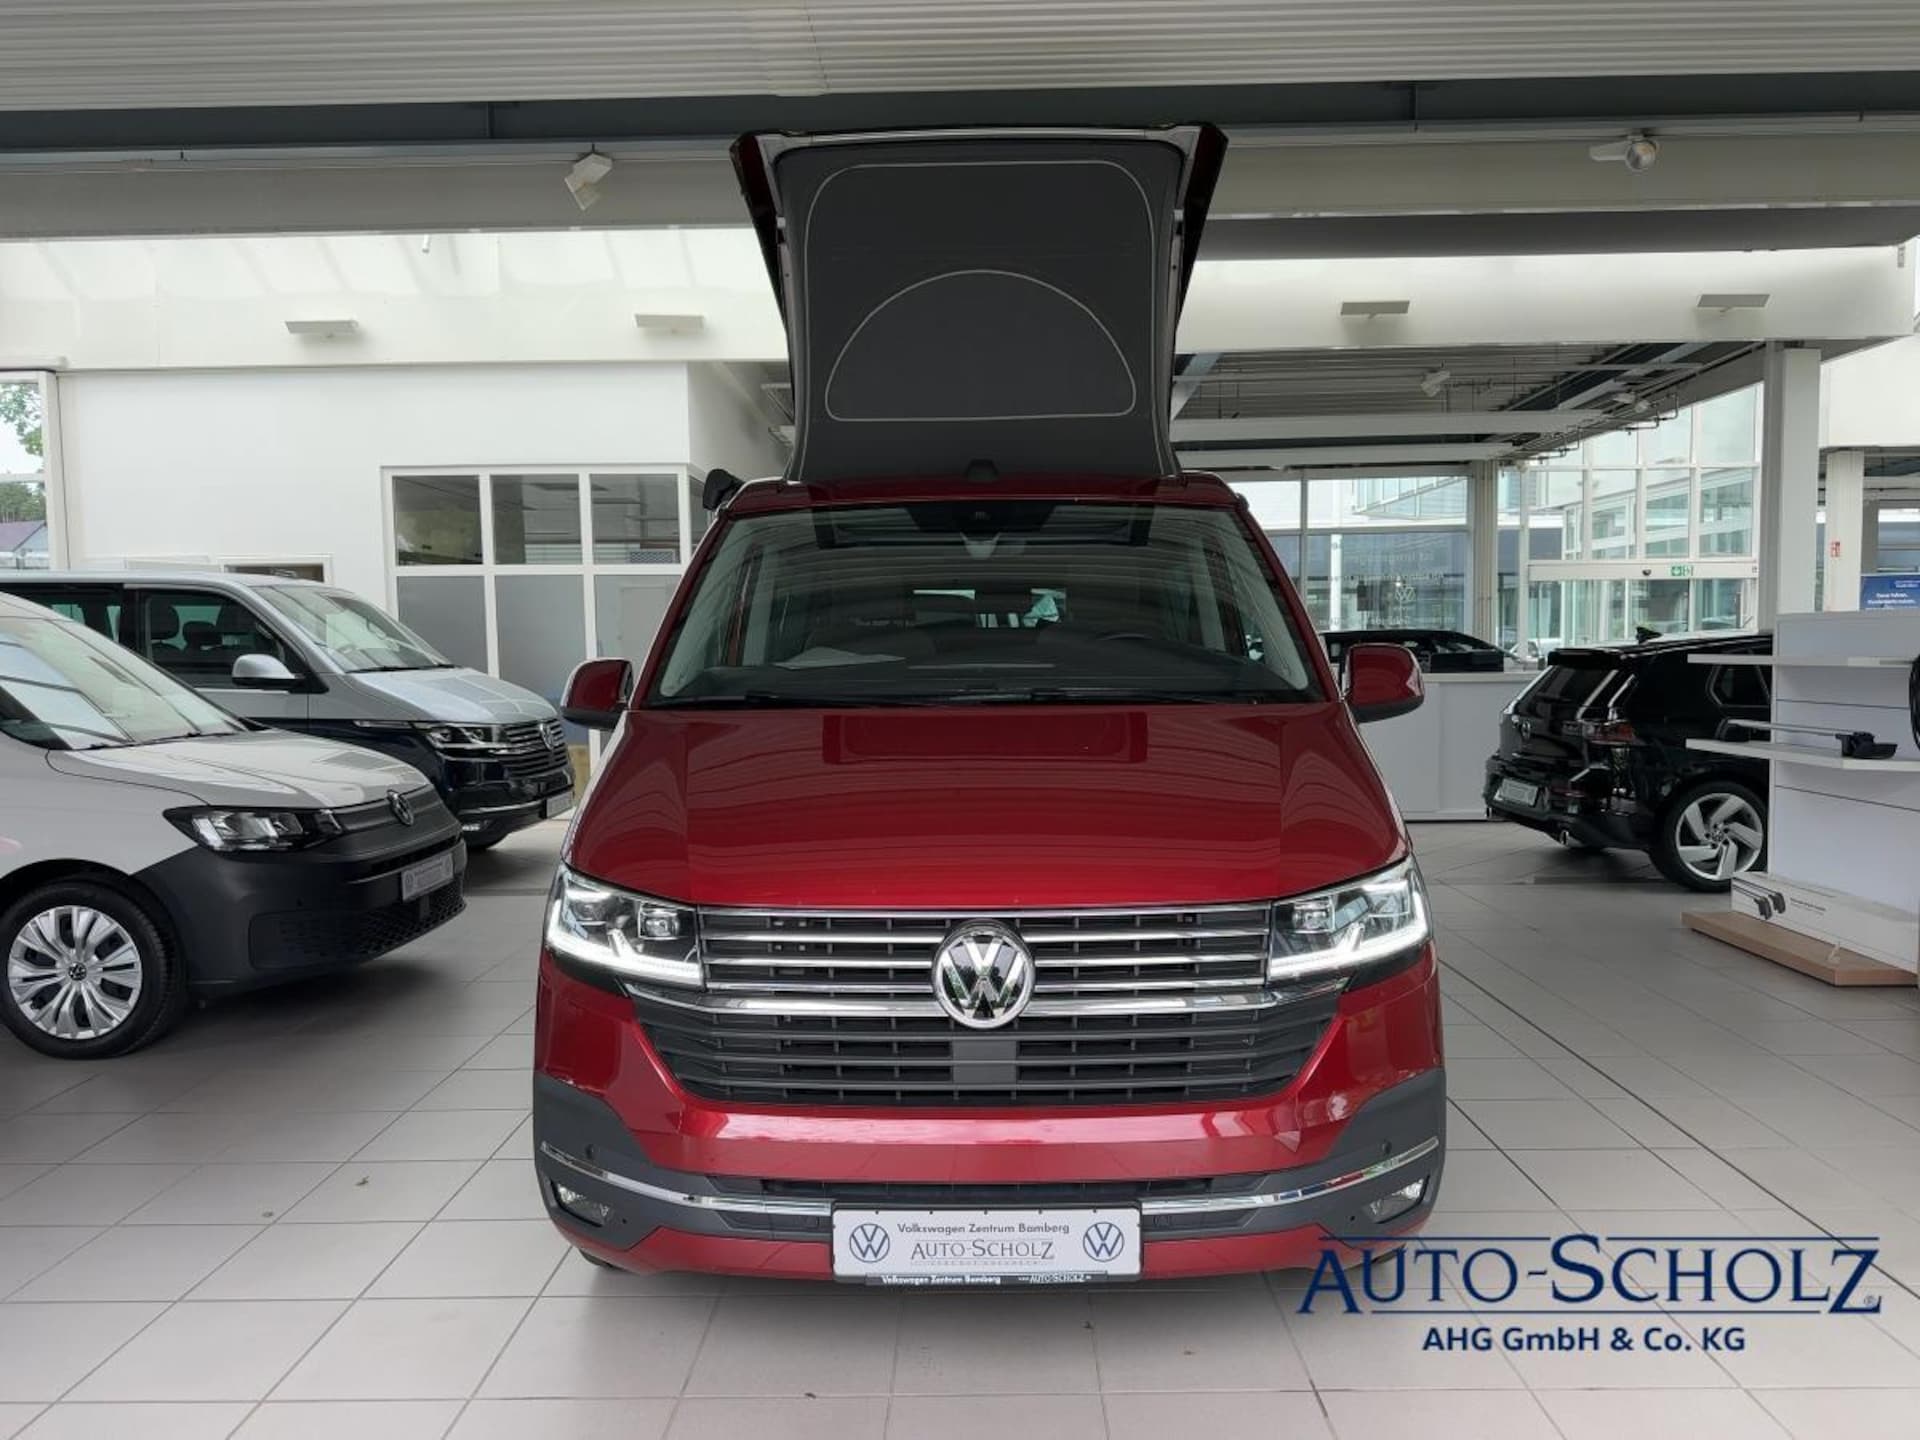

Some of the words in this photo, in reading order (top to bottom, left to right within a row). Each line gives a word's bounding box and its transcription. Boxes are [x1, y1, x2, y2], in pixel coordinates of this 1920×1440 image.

[897, 1223, 965, 1236] Volkswagen
[968, 1223, 1015, 1234] Zentrum
[1018, 1221, 1070, 1235] Bamberg
[911, 1239, 1055, 1261] AUTO-SCHOLZ
